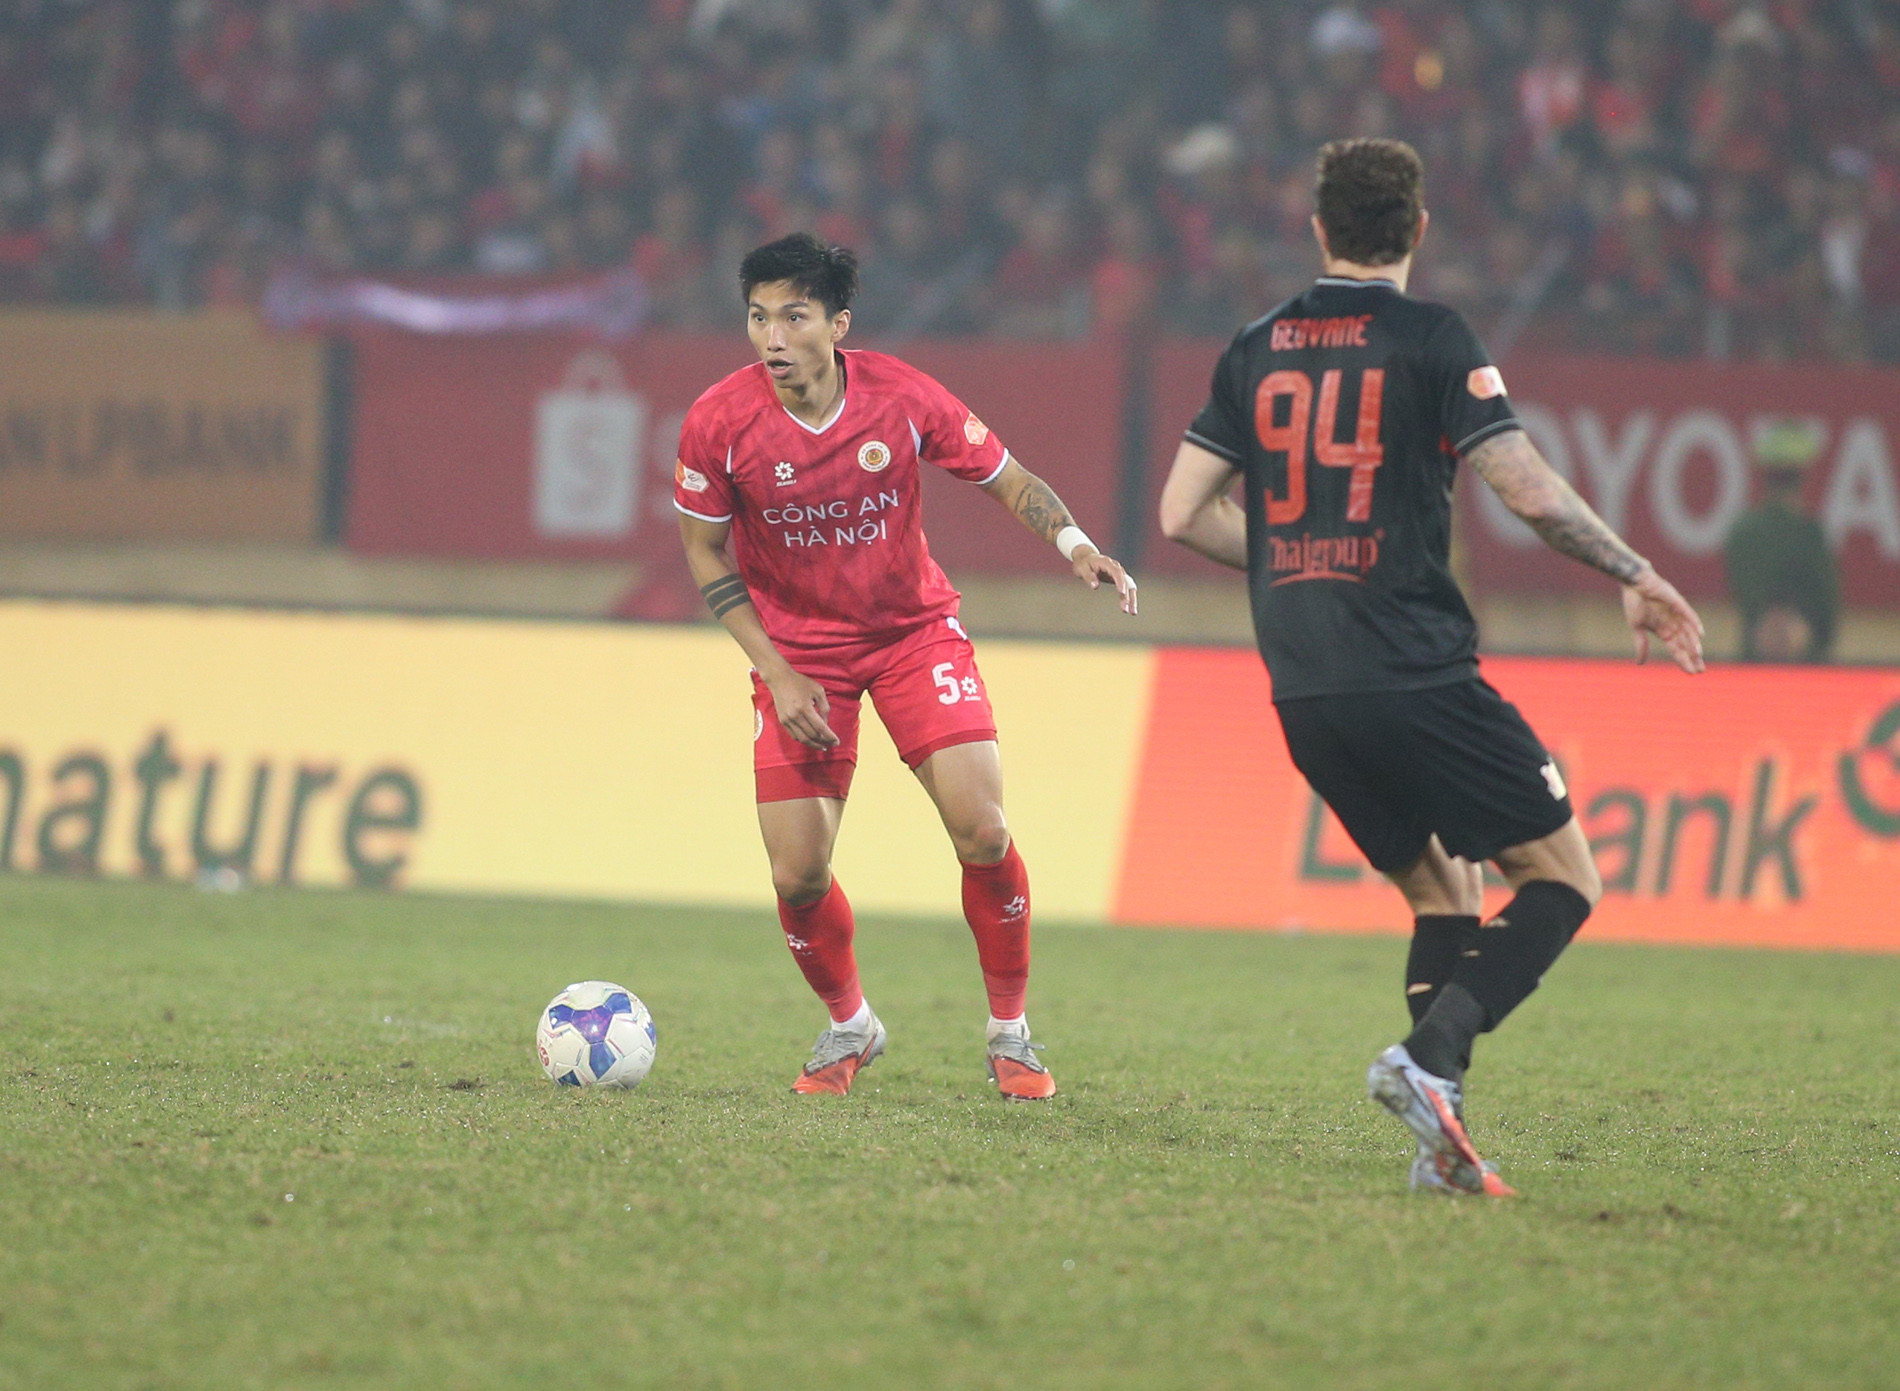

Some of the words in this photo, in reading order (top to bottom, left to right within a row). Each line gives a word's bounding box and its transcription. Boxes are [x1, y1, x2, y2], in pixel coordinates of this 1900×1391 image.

[1254, 368, 1385, 525] 94
[1473, 404, 1900, 559] OYOA
[762, 502, 849, 525] CÔNG
[858, 488, 900, 517] AN
[783, 525, 828, 548] HÀ
[834, 518, 887, 546] NỘI
[931, 661, 962, 705] 5
[1299, 755, 1819, 901] Lank
